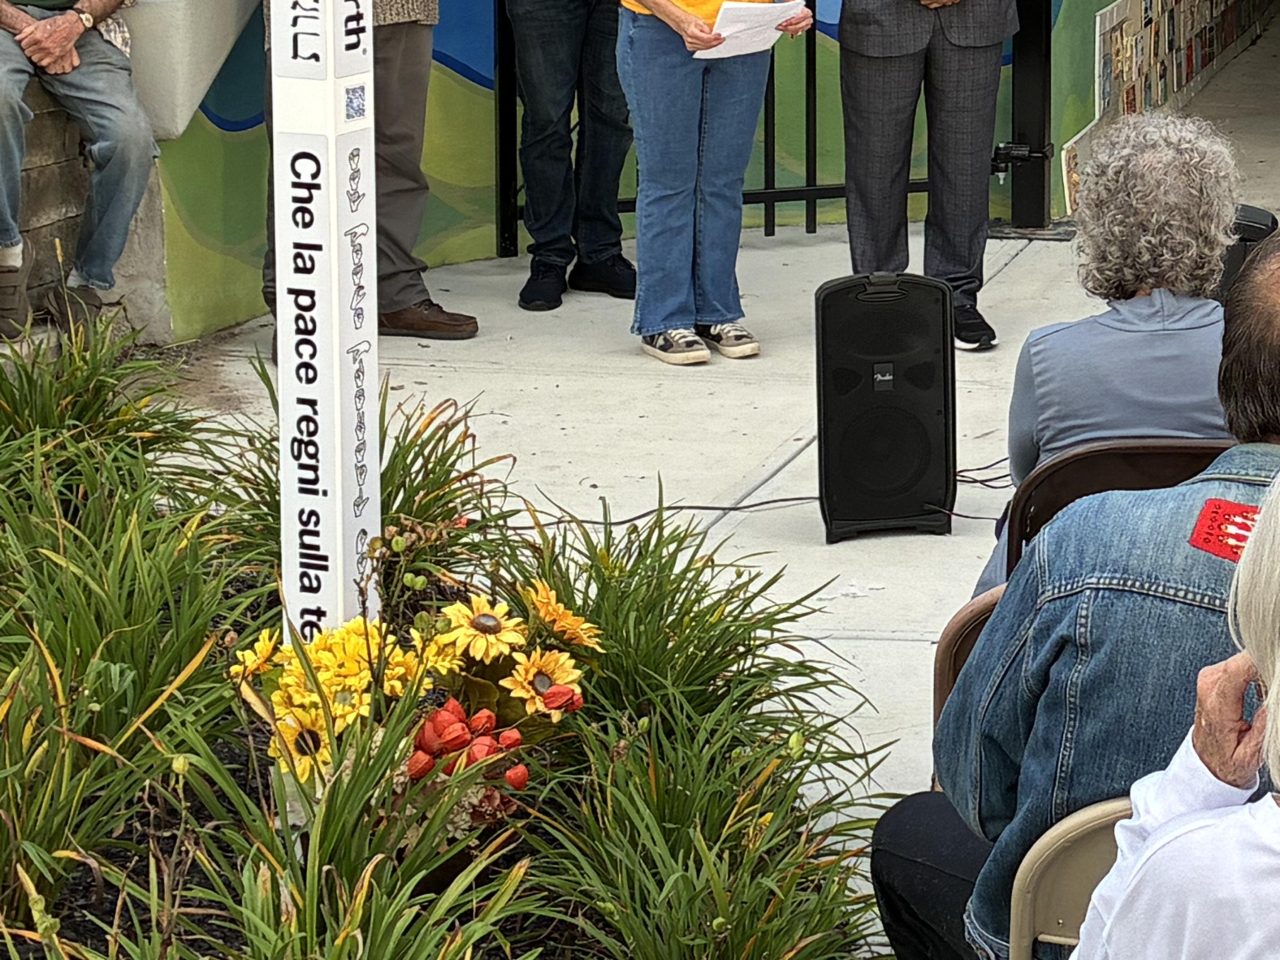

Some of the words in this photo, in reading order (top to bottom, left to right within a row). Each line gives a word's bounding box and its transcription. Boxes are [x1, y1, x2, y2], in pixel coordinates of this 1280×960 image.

[290, 152, 321, 229] Che
[292, 242, 323, 275] la
[287, 288, 318, 385] pace
[290, 397, 328, 497] regni
[297, 508, 329, 594] sulla
